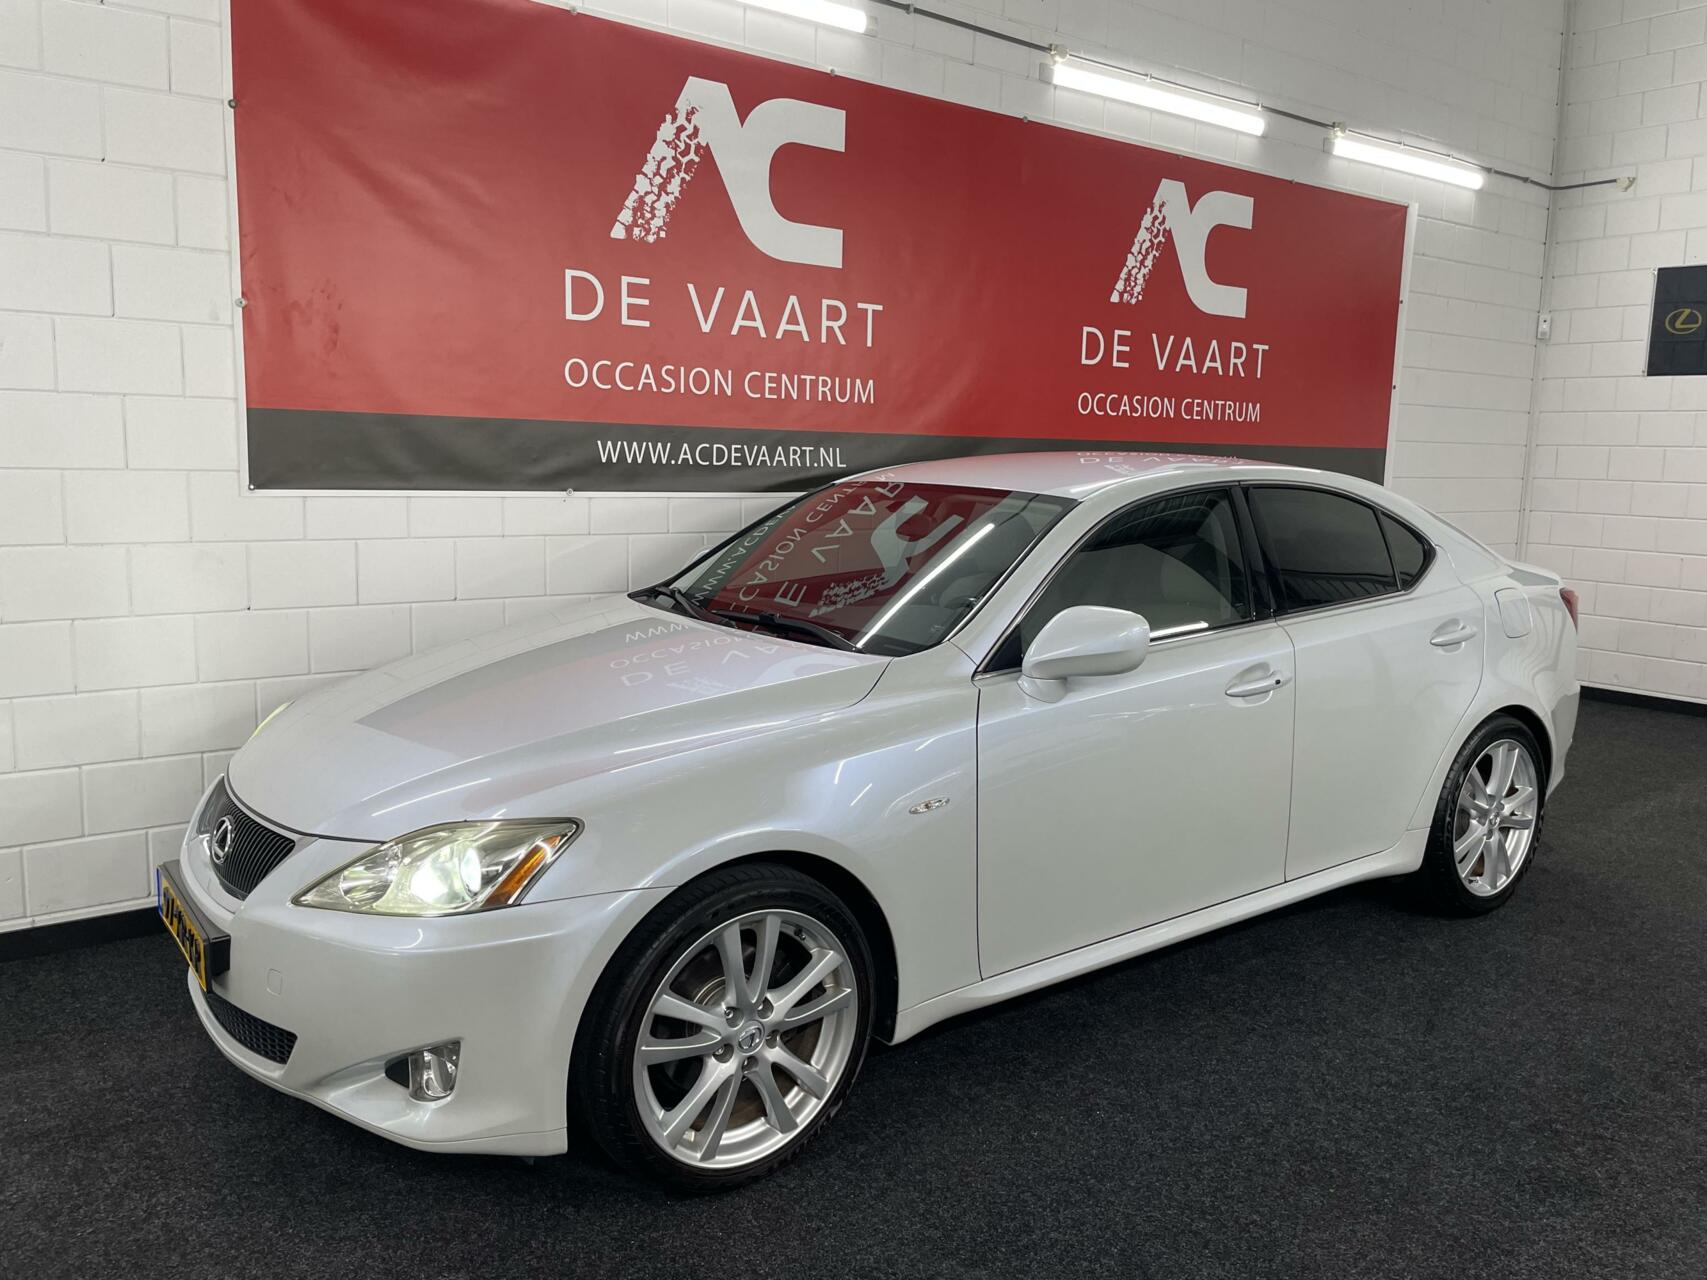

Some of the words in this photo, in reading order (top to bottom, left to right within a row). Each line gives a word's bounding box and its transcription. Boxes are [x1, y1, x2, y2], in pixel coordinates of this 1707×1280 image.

[610, 75, 847, 269] AC
[1110, 178, 1255, 319] AC
[565, 268, 650, 328] DE
[687, 283, 883, 347] VAART
[1081, 326, 1132, 368] DE
[1152, 333, 1269, 379] VAART
[564, 358, 732, 396] OCCASION
[744, 371, 875, 404] CENTRUM
[1077, 392, 1175, 418] OCCASION
[1181, 398, 1261, 422] CENTRUM
[597, 440, 847, 468] WWW.ACDEVAART.NL
